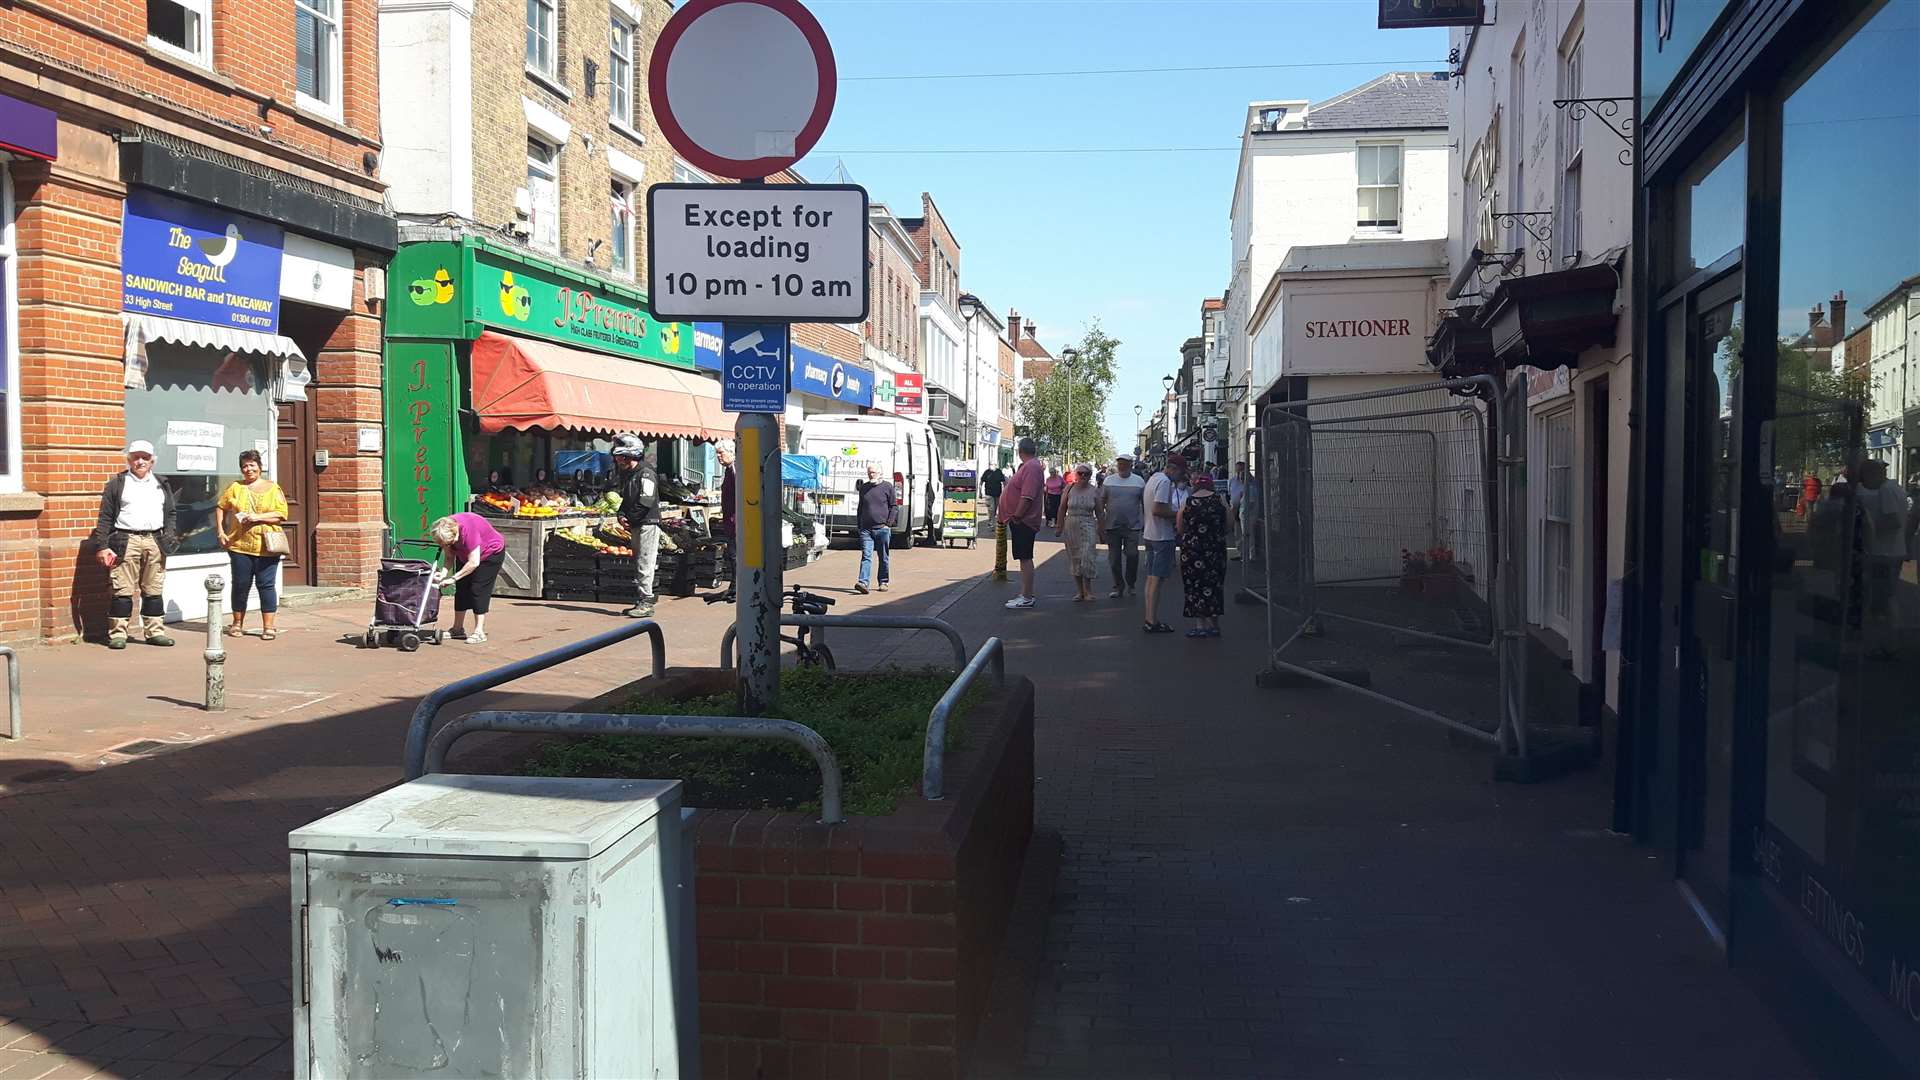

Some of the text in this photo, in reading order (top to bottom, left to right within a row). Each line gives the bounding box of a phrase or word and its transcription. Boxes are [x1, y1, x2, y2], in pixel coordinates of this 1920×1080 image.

[685, 203, 833, 231] Except for
[168, 226, 192, 249] The
[707, 235, 810, 263] loading
[177, 256, 226, 283] Seagull
[126, 274, 273, 313] SANDWICH BAR and TAKEAWAY
[665, 273, 697, 296] 10
[705, 278, 747, 300] pm
[771, 273, 803, 297] 10
[811, 279, 851, 297] am
[124, 294, 173, 312] 33 High Street
[1305, 319, 1411, 338] STATIONER
[694, 330, 723, 357] armacy
[731, 365, 776, 380] CCTV
[804, 362, 828, 386] pharmacy
[727, 381, 781, 392] in operation
[1753, 825, 1783, 885] SALES
[1801, 870, 1865, 966] LETTINGS
